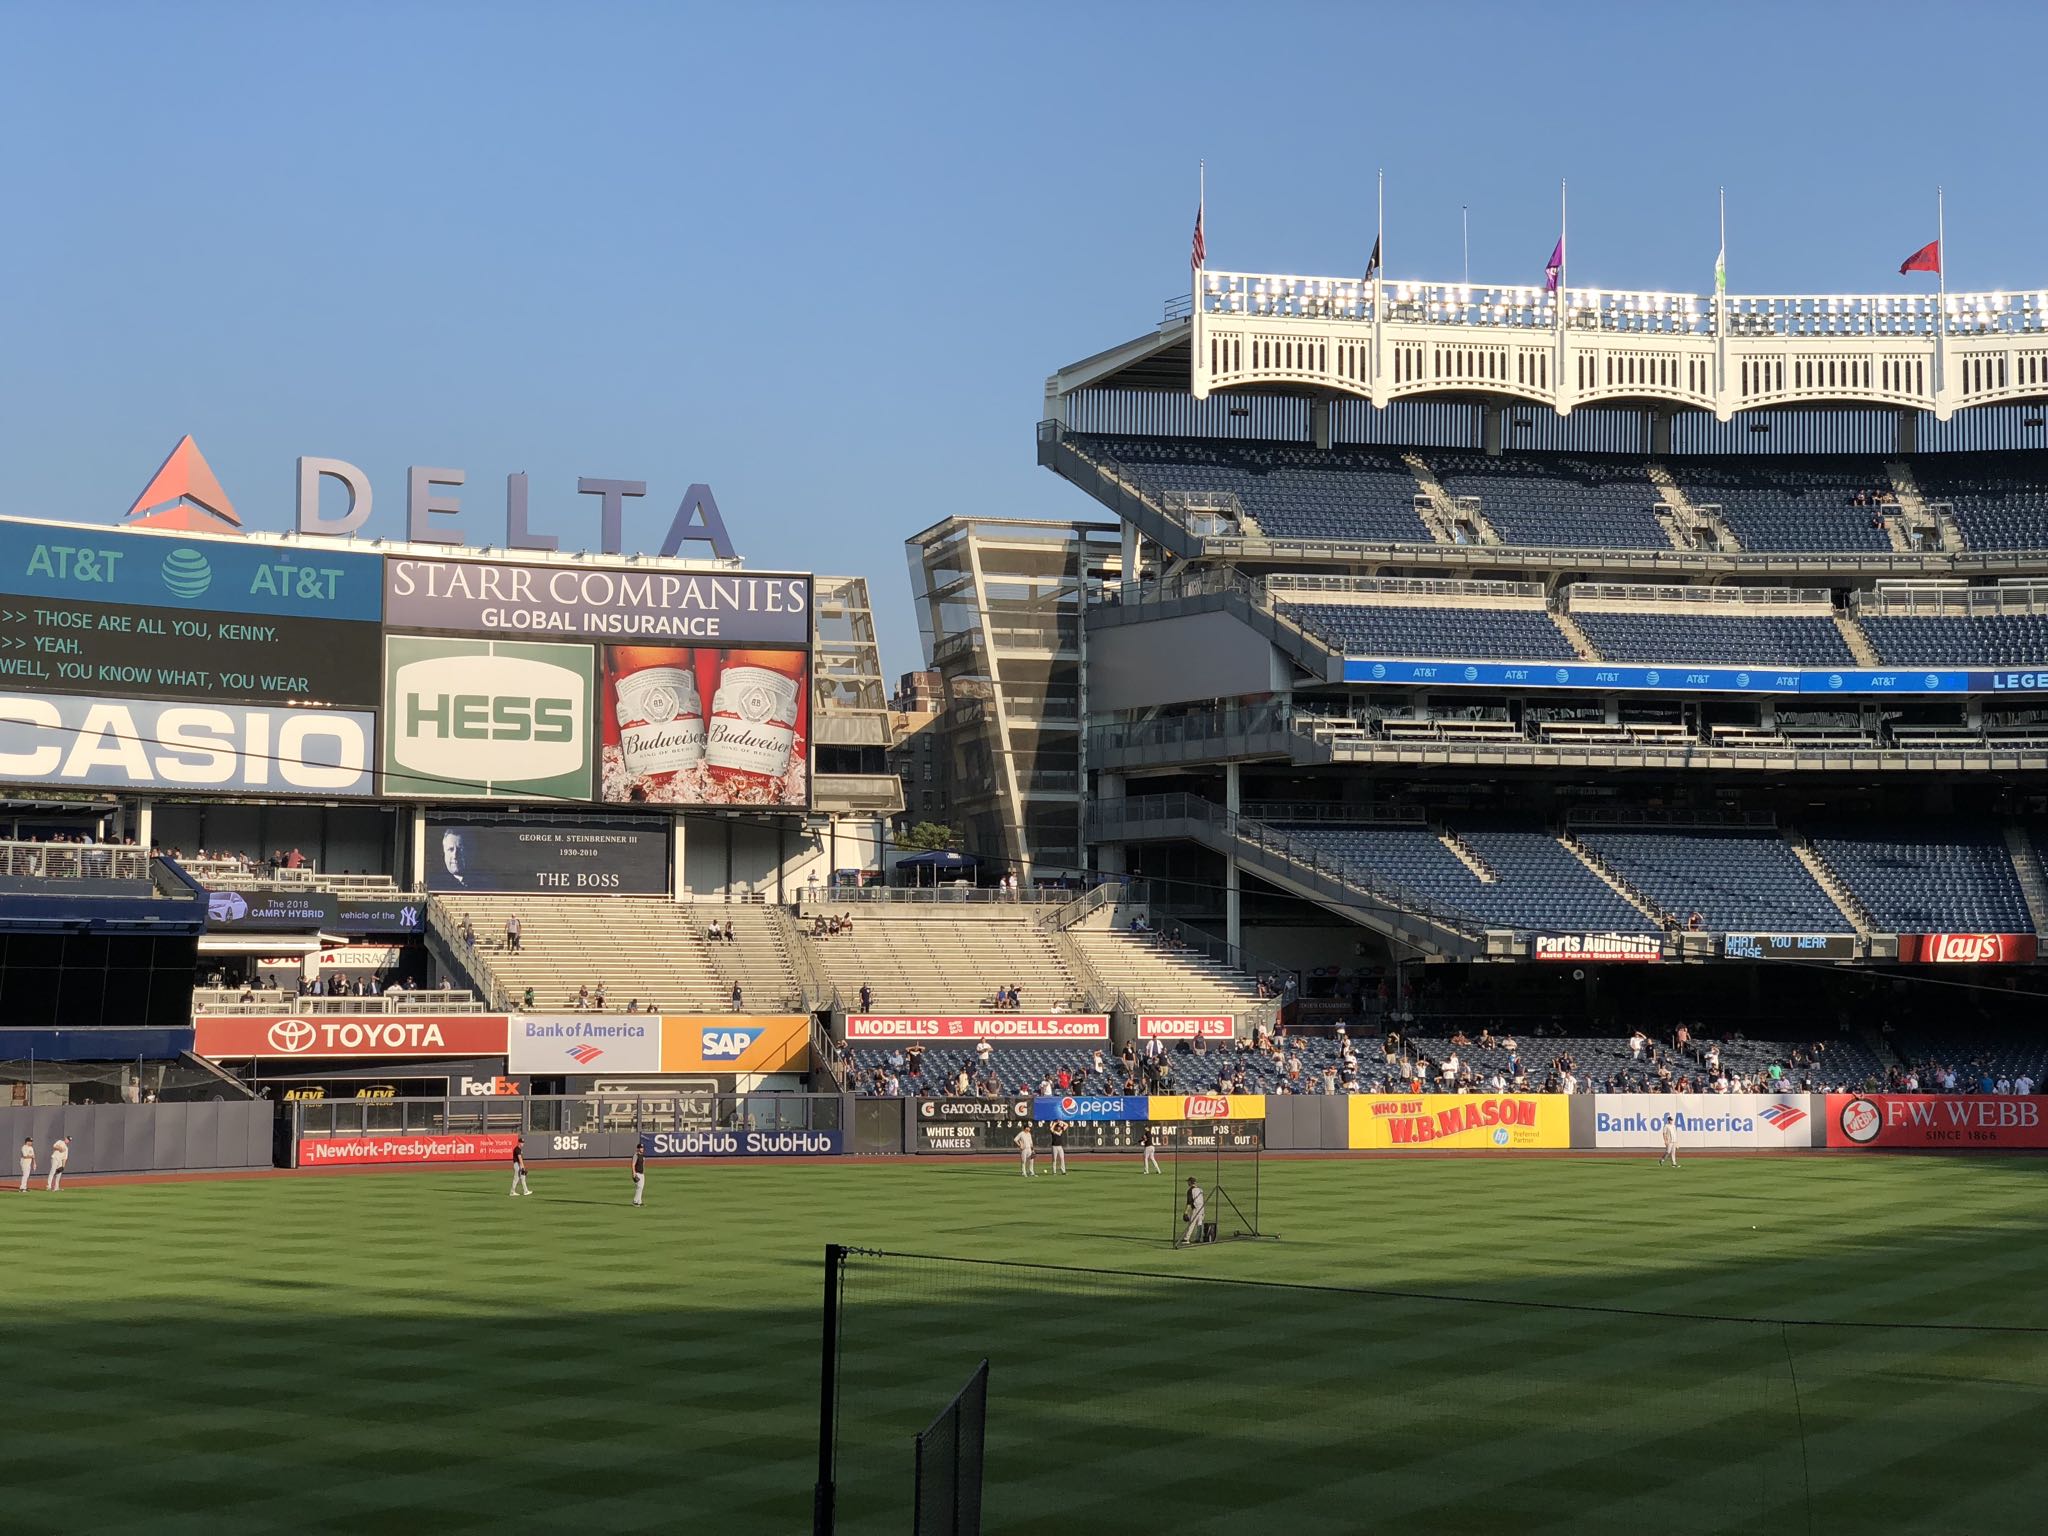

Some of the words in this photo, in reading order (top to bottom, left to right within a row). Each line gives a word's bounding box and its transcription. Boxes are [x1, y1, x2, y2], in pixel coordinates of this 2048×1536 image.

[296, 456, 736, 559] DELTA
[26, 544, 123, 583] AT&T
[250, 563, 344, 600] AT&T
[394, 561, 541, 603] STARR
[549, 571, 805, 613] COMPANIES
[34, 610, 93, 629] THOSE
[98, 616, 131, 632] ARE
[137, 619, 166, 635] ALL
[172, 621, 212, 640] YOU,
[219, 624, 279, 642] KENNY.
[481, 608, 577, 631] GLOBAL
[583, 612, 720, 636] INSURANCE
[34, 636, 83, 654] YEAH.
[0, 658, 50, 680] WELL,
[57, 662, 93, 679] YOU
[99, 665, 152, 684] KNOW
[157, 668, 214, 690] WHAT,
[219, 672, 255, 690] YOU
[260, 675, 309, 693] WEAR
[1413, 667, 1437, 677] AT&T
[1505, 670, 1529, 680] AT&T
[1595, 672, 1619, 682] AT&T
[1686, 674, 1710, 684] AT&T
[1775, 676, 1799, 686] AT&T
[1871, 676, 1896, 687] AT&T
[407, 692, 573, 743] HESS
[0, 697, 365, 788] CASIO
[624, 729, 705, 756] Budweiser
[711, 723, 790, 754] Budweiser
[519, 834, 552, 842] GEORGE
[554, 834, 564, 842] M.
[566, 835, 627, 843] STEINBRENNER
[629, 836, 637, 844] III
[559, 848, 598, 856] 1930-2010
[536, 873, 570, 886] THE
[577, 873, 620, 887] BOSS
[268, 899, 285, 909] The
[287, 899, 309, 909] 2018
[251, 909, 287, 918] CAMRY
[288, 909, 324, 919] HYBRID
[340, 911, 369, 920] vehicle
[371, 911, 380, 920] of
[382, 911, 395, 920] the
[1537, 936, 1581, 952] Parts
[1583, 932, 1662, 953] Authority
[1770, 936, 1791, 948] YOU
[1798, 936, 1827, 948] WEAR
[526, 1022, 564, 1037] Bank
[566, 1022, 580, 1037] of
[583, 1022, 645, 1037] America
[854, 1019, 939, 1034] MODELL'S
[974, 1019, 1100, 1034] MODELLS.com
[1147, 1020, 1225, 1034] MODELL'S
[321, 1023, 445, 1048] TOYOTA
[703, 1032, 751, 1056] SAP
[356, 1088, 396, 1099] ALEVE
[461, 1076, 519, 1096] FedEx
[283, 1089, 325, 1101] ALEVE
[921, 1101, 935, 1117] G
[941, 1103, 1009, 1114] GATORADE
[1014, 1101, 1028, 1117] G
[1081, 1098, 1124, 1115] pepsi
[1187, 1097, 1226, 1119] Lay's
[1372, 1102, 1398, 1115] WHO
[1400, 1102, 1423, 1114] BUT
[1886, 1101, 1938, 1127] F.W.
[1944, 1101, 2039, 1127] WEBB
[1599, 1112, 1648, 1132] Bank
[1675, 1112, 1754, 1133] America
[926, 1127, 955, 1137] WHITE
[957, 1127, 976, 1137] SOX
[1151, 1126, 1161, 1135] AT
[1162, 1126, 1177, 1135] BAT
[1213, 1126, 1229, 1134] POS
[1926, 1131, 1961, 1140] SINCE
[1968, 1131, 1997, 1140] 1866
[553, 1136, 579, 1150] 385
[653, 1133, 737, 1153] StubHub
[747, 1133, 831, 1152] StubHub
[930, 1138, 971, 1149] YANKEES
[1187, 1136, 1215, 1146] STRIKE
[1234, 1136, 1250, 1145] OUT
